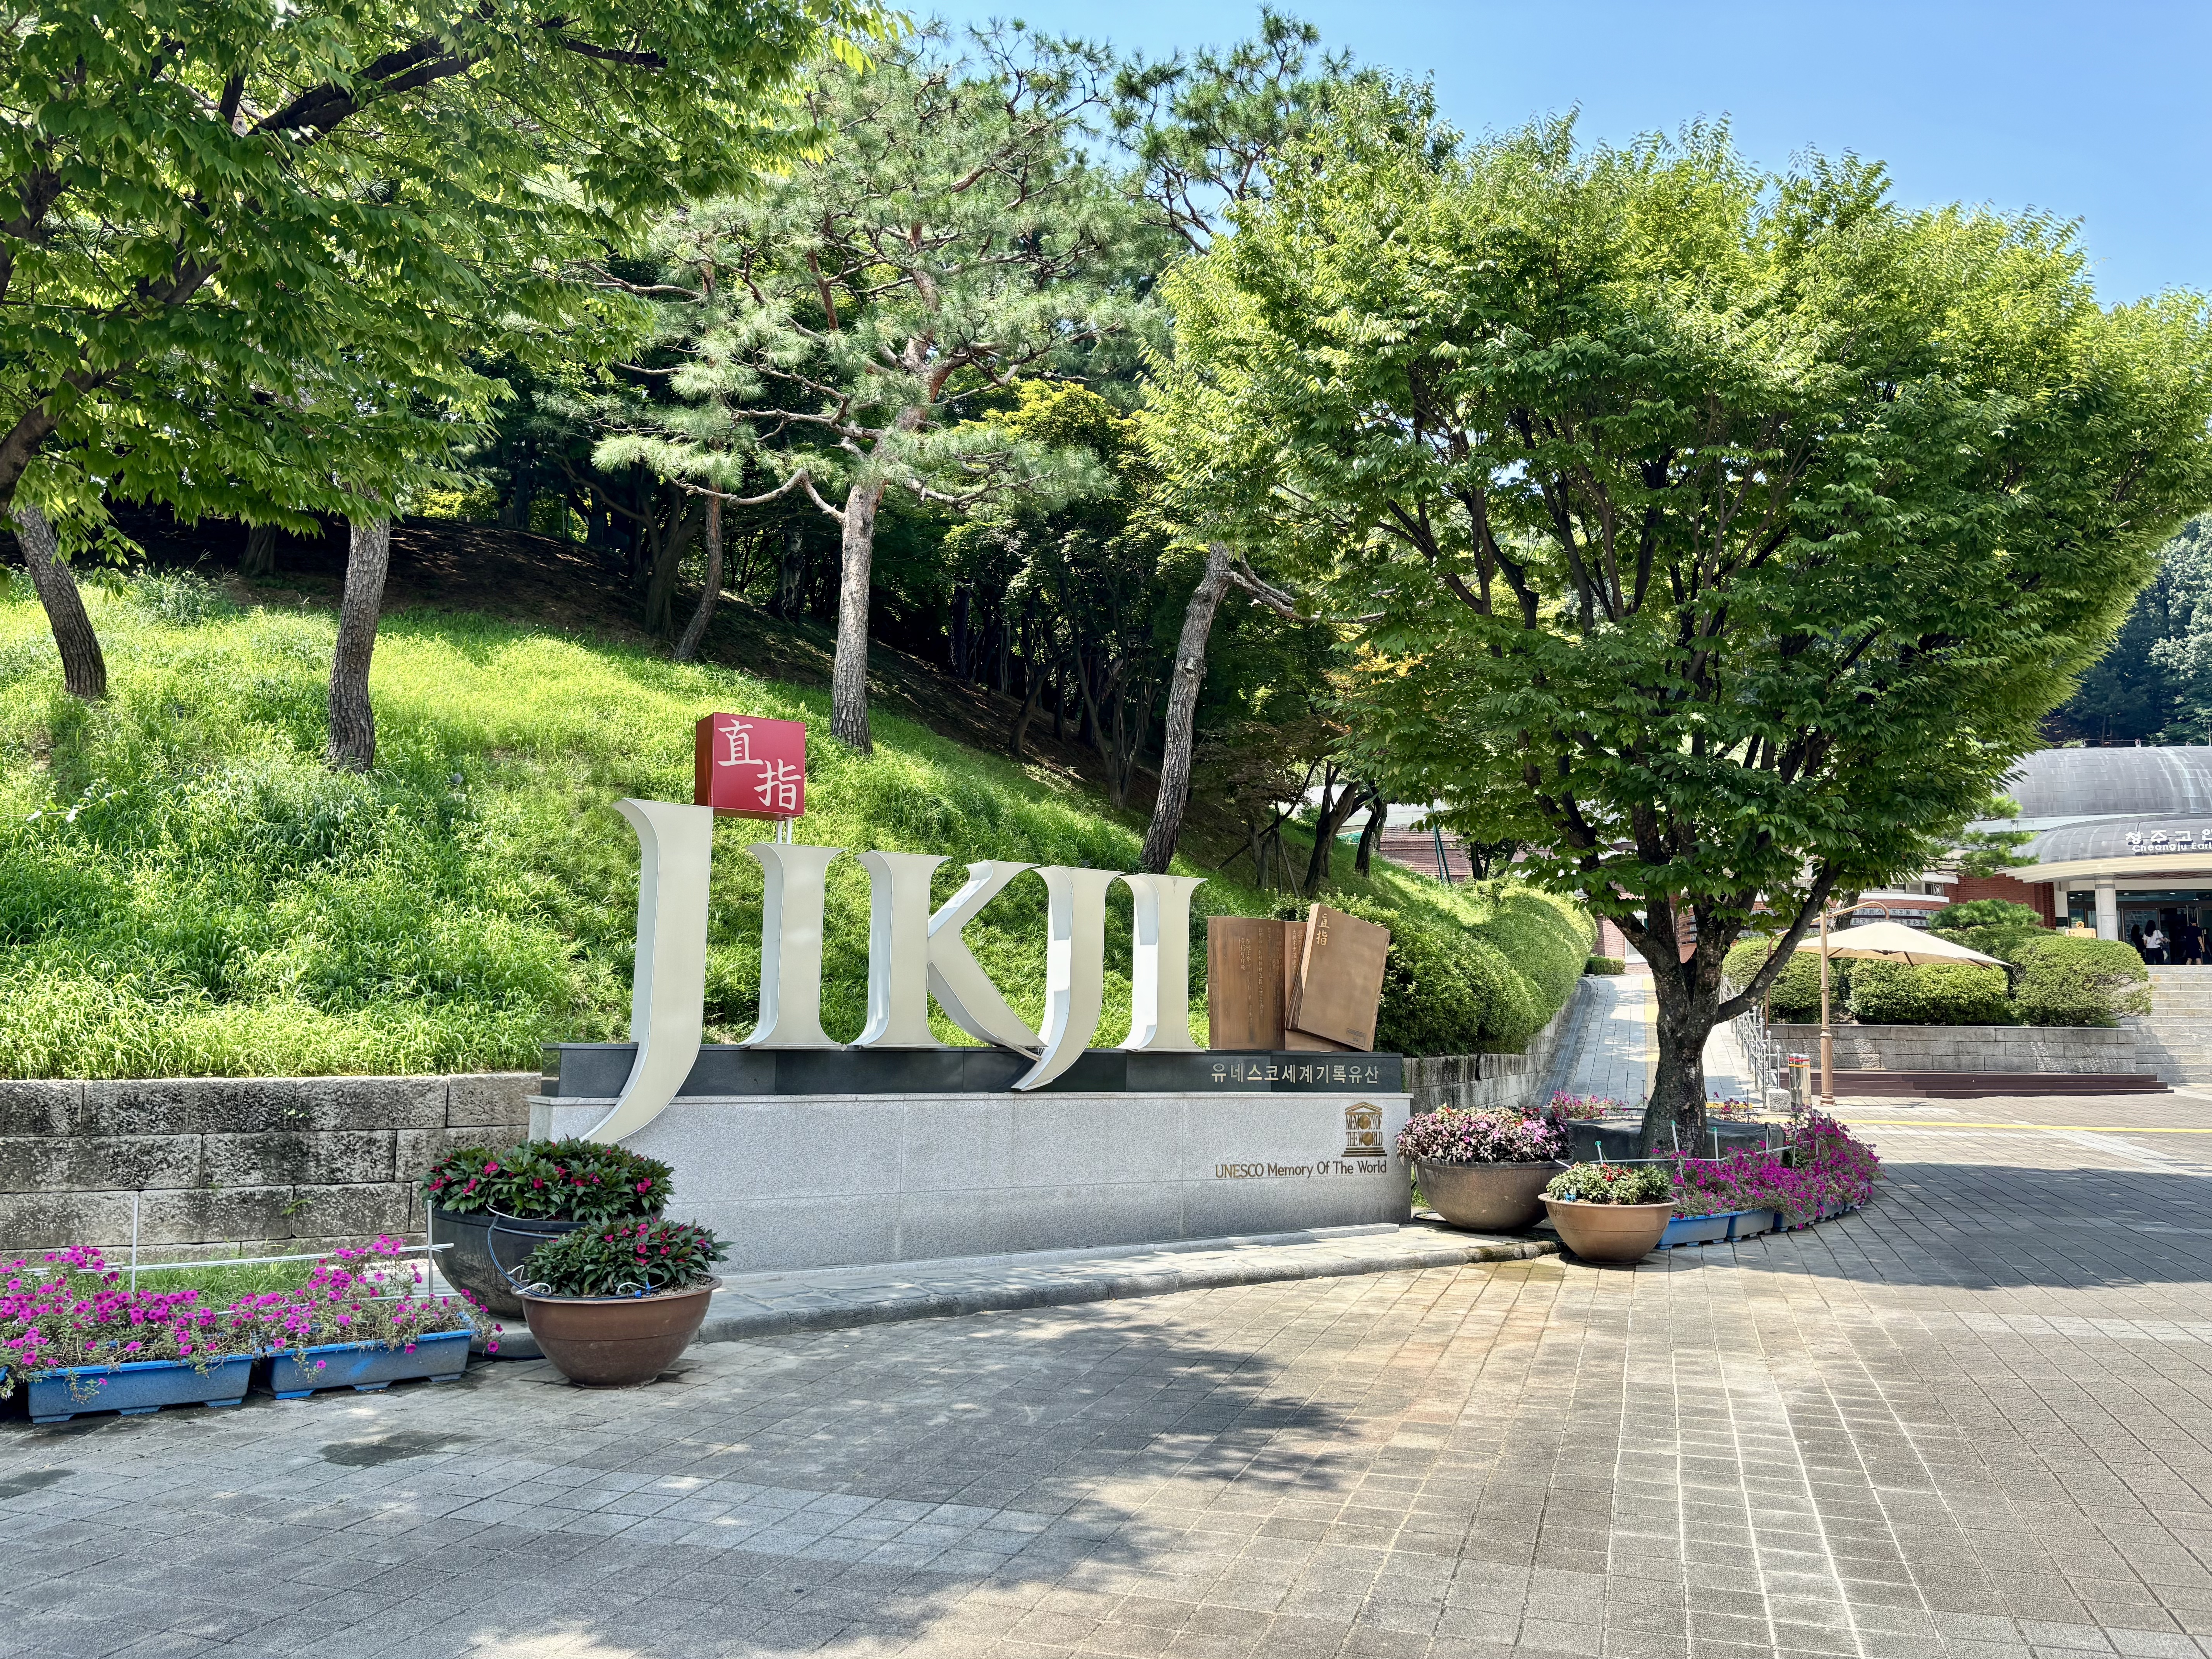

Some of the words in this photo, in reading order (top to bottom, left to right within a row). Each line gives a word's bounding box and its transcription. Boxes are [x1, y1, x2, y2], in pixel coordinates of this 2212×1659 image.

[718, 719, 802, 810] 直指
[2132, 842, 2187, 852] Cheongju
[1316, 913, 1330, 946] 直指
[580, 798, 1208, 1145] JIKJI
[1215, 1163, 1264, 1178] UNESCO
[1267, 1163, 1314, 1179] Memory
[1317, 1161, 1330, 1175] Of
[1333, 1161, 1354, 1174] The
[1357, 1159, 1387, 1173] World
